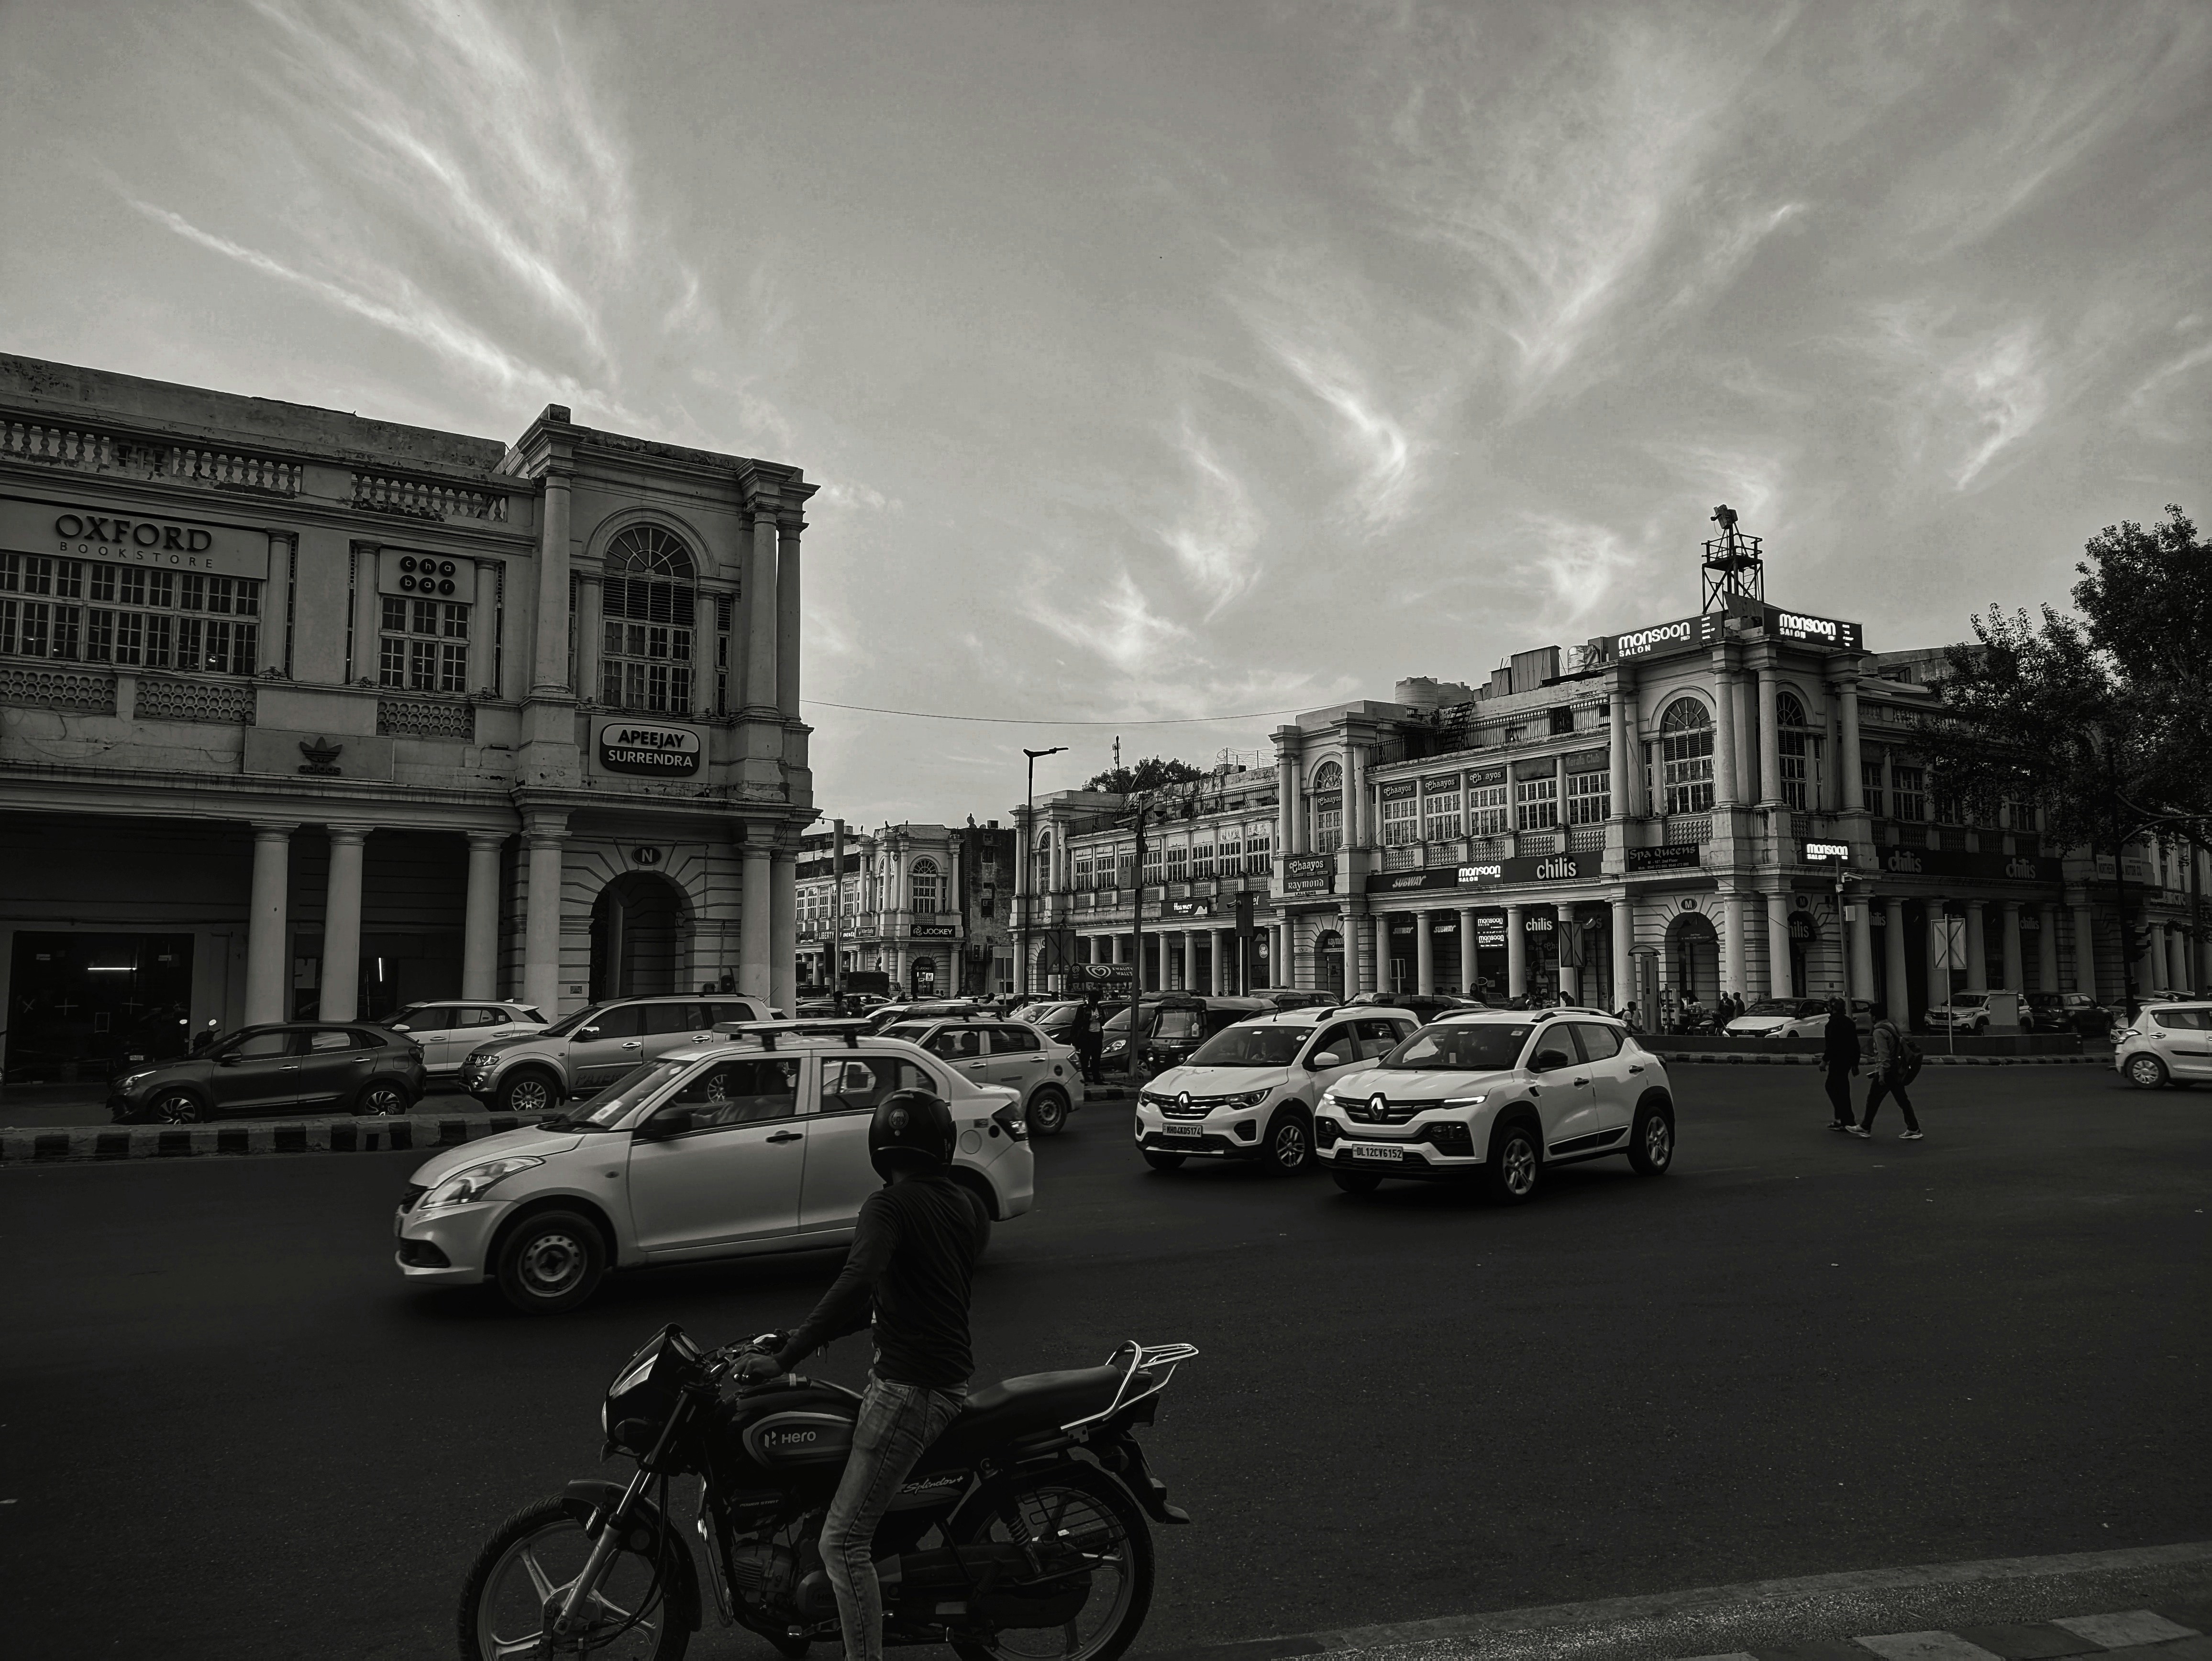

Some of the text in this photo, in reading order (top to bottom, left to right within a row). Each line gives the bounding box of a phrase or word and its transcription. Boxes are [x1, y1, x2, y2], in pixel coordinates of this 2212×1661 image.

[55, 514, 212, 552] OXFORD
[60, 542, 212, 568] BOOKSTORE
[405, 559, 452, 572] cha
[404, 577, 450, 591] bar
[1780, 613, 1836, 636] monsoon
[1618, 622, 1690, 650] monsoon
[1780, 627, 1806, 639] SALON
[1619, 644, 1651, 657] SALON
[618, 729, 685, 749] APEEJAY
[608, 750, 693, 767] SURRENDRA
[1566, 753, 1600, 767] Kerala Club
[299, 764, 341, 775] adidas
[1470, 771, 1502, 784] Chayos
[1383, 784, 1412, 797] Chaayos
[1425, 778, 1455, 791] Chaayos
[1317, 795, 1342, 805] Chaayos
[641, 849, 653, 862] N
[1629, 846, 1696, 861] Spa Queens
[1807, 843, 1848, 855] monsoon
[1289, 860, 1324, 873] Chaayos
[1459, 865, 1501, 878] monsoon
[1288, 879, 1324, 891] Raymond
[1393, 875, 1427, 888] SUBWAY
[1684, 899, 1692, 909] M
[1800, 898, 1806, 907] M
[818, 931, 835, 940] LIBERTY
[1433, 925, 1457, 933] SUBWAY
[1167, 1126, 1201, 1135] MH04KD5174
[1357, 1147, 1402, 1158] DL12CV6152
[781, 1431, 816, 1444] Hero
